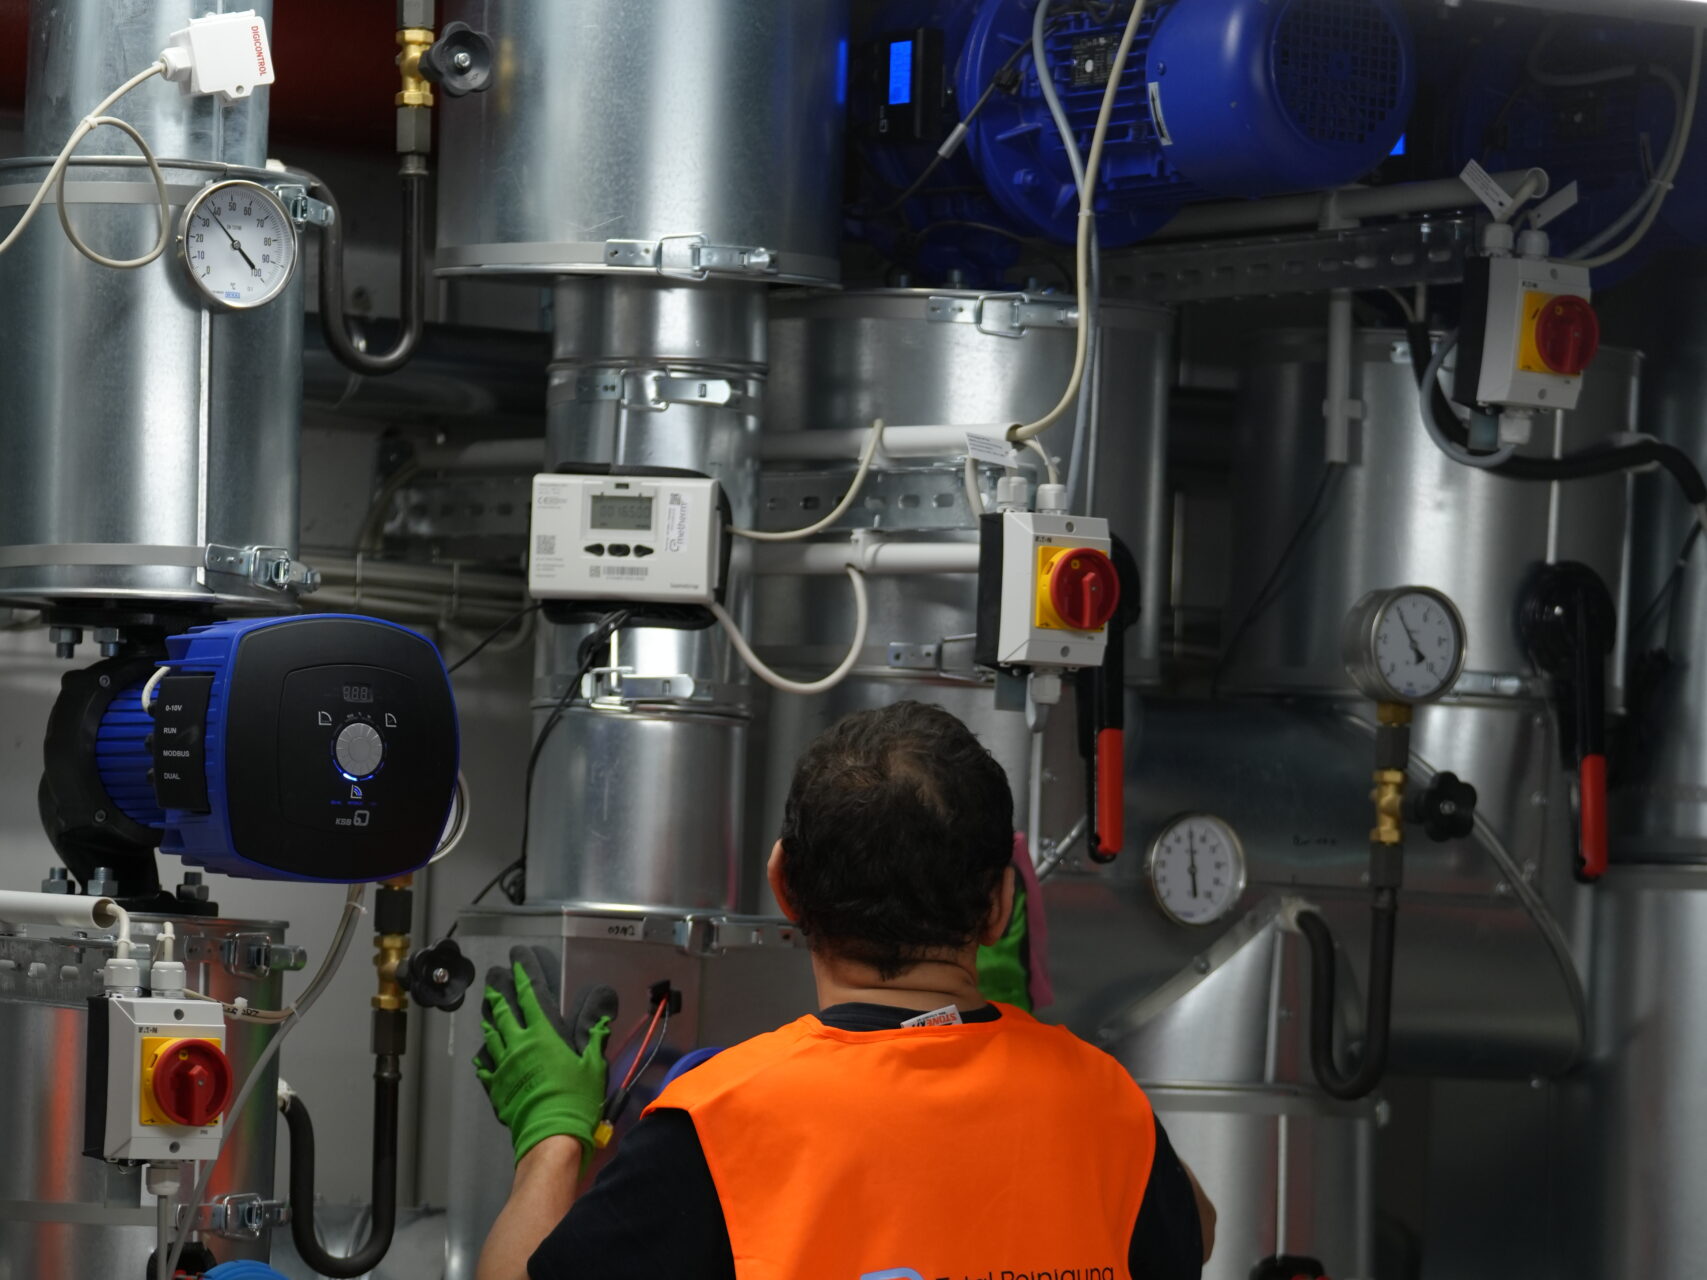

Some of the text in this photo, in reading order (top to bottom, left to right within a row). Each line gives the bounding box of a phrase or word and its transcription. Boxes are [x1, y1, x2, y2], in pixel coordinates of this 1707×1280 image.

[251, 25, 267, 77] DIGICONTROL
[228, 201, 237, 211] 50
[213, 206, 222, 216] 40
[243, 206, 252, 216] 60
[201, 218, 210, 227] 30
[256, 218, 265, 228] 70
[195, 234, 204, 242] 20
[263, 237, 272, 246] 80
[197, 250, 205, 260] 10
[262, 254, 270, 263] 90
[206, 265, 211, 275] 0
[250, 268, 262, 277] 100
[165, 704, 183, 712] 0-10V
[162, 749, 190, 757] MODBUS
[163, 772, 181, 780] DUAL
[335, 817, 352, 826] KSB
